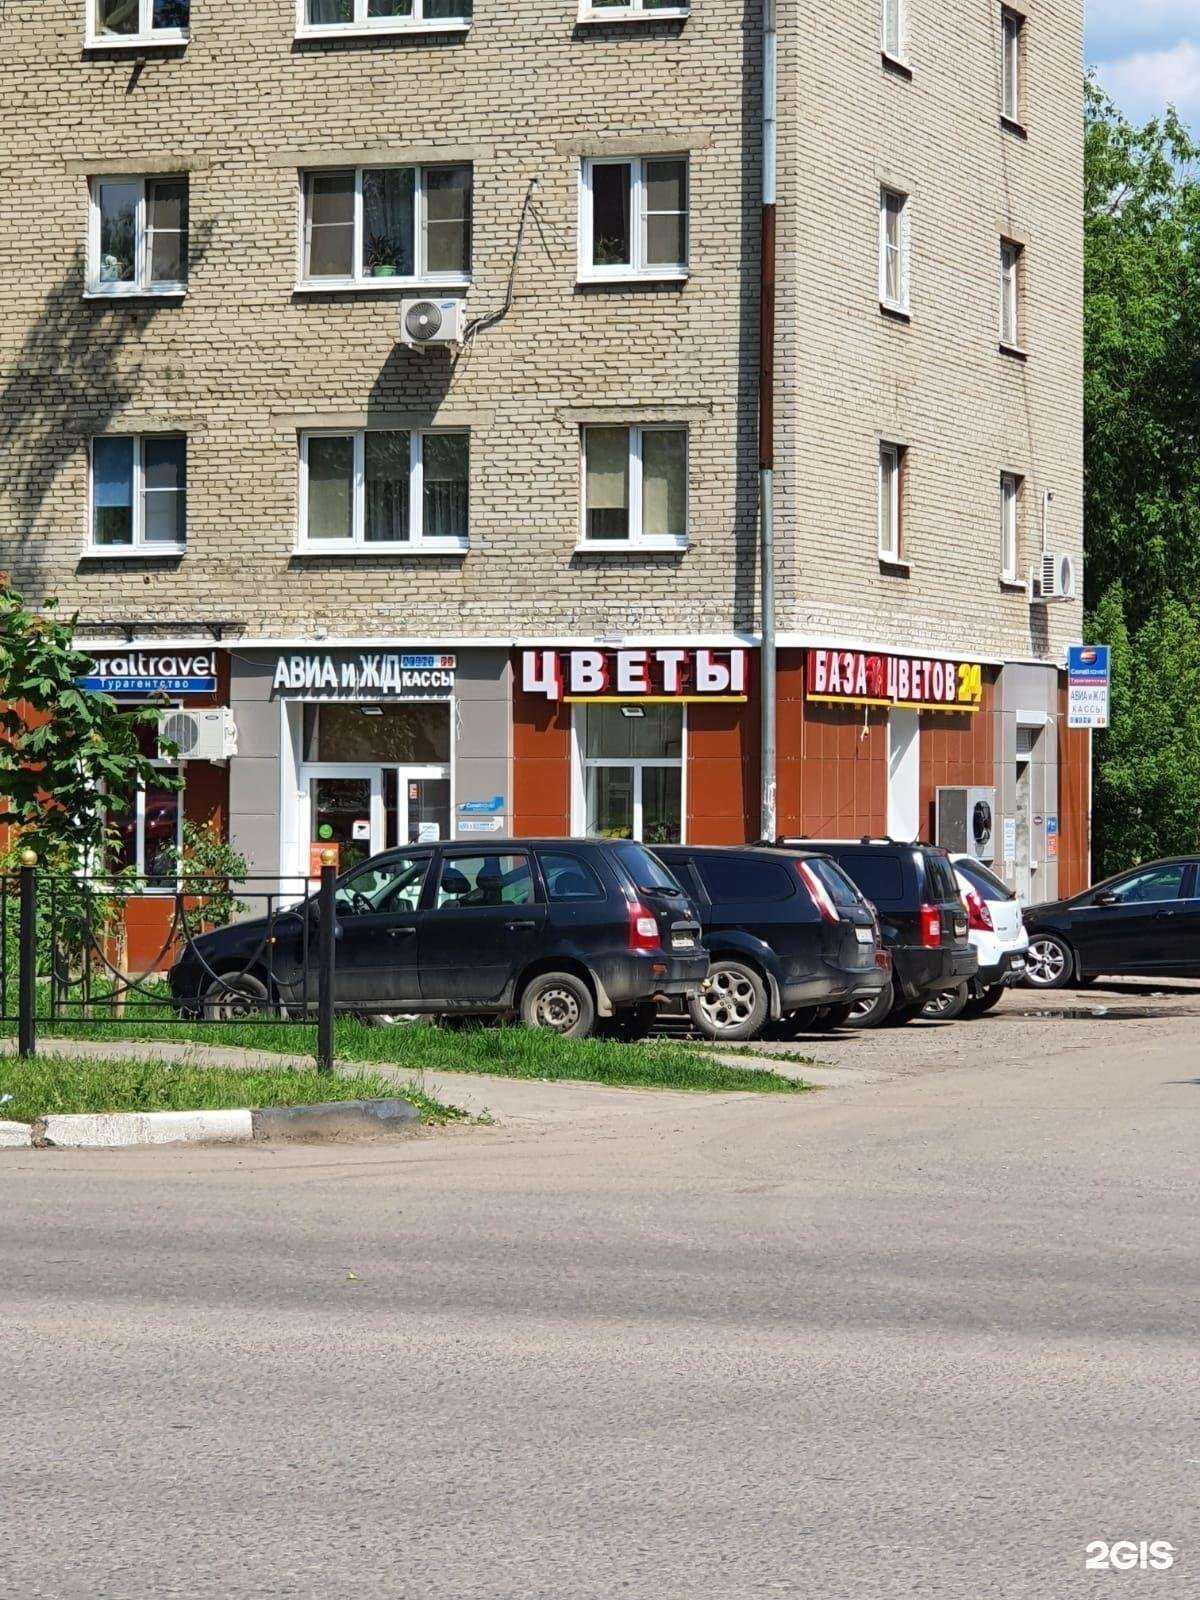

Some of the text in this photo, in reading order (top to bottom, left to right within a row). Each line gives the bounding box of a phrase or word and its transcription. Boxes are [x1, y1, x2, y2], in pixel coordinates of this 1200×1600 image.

[87, 651, 218, 676] oraltravel
[273, 655, 339, 689] АВИА
[341, 662, 356, 688] и
[522, 650, 744, 700] ЦВЕТЫ
[101, 679, 190, 690] Турагентство
[402, 670, 456, 688] КАССЫ
[815, 650, 983, 704] БАЗА ЦВЕТОВ 24
[1071, 705, 1104, 714] КАССЫ
